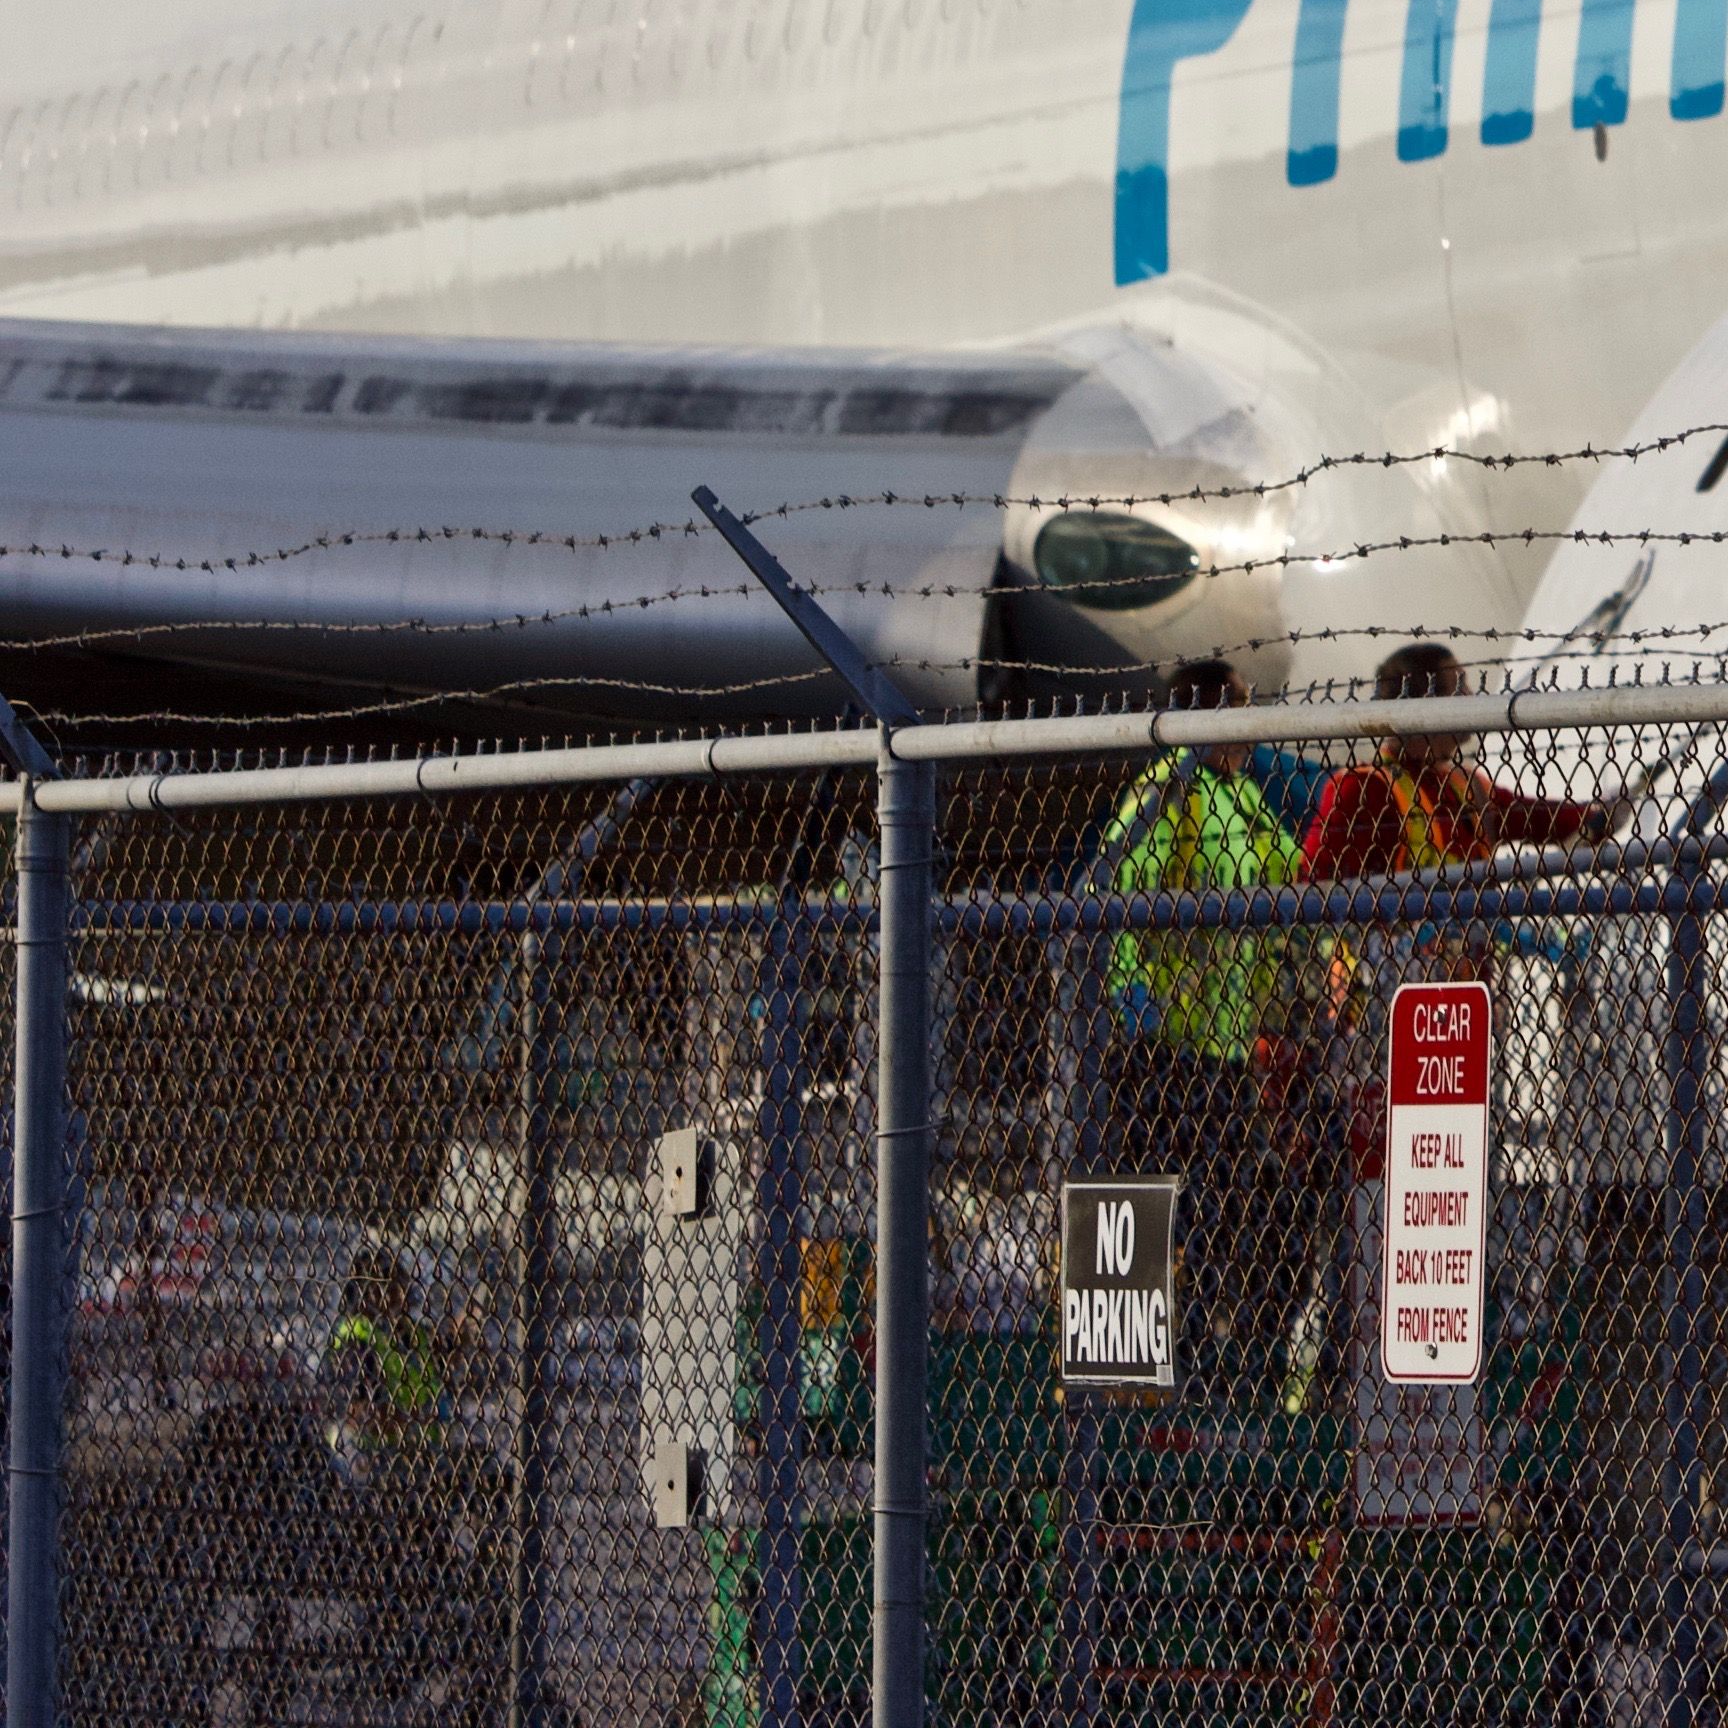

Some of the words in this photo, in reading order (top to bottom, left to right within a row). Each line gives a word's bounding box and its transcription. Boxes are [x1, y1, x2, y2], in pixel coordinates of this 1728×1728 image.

[1413, 1003, 1471, 1043] CLEAR
[1416, 1056, 1465, 1095] ZONE
[1412, 1133, 1441, 1168] KEEP
[1444, 1133, 1464, 1168] ALL
[1404, 1191, 1468, 1227] EQUIPMENT
[1096, 1200, 1135, 1276] NO
[1396, 1249, 1427, 1285] BACK
[1431, 1249, 1442, 1285] 10
[1446, 1249, 1472, 1284] FEET
[1065, 1288, 1167, 1365] PARKING
[1397, 1307, 1429, 1343] FROM
[1433, 1307, 1468, 1343] FENCE
